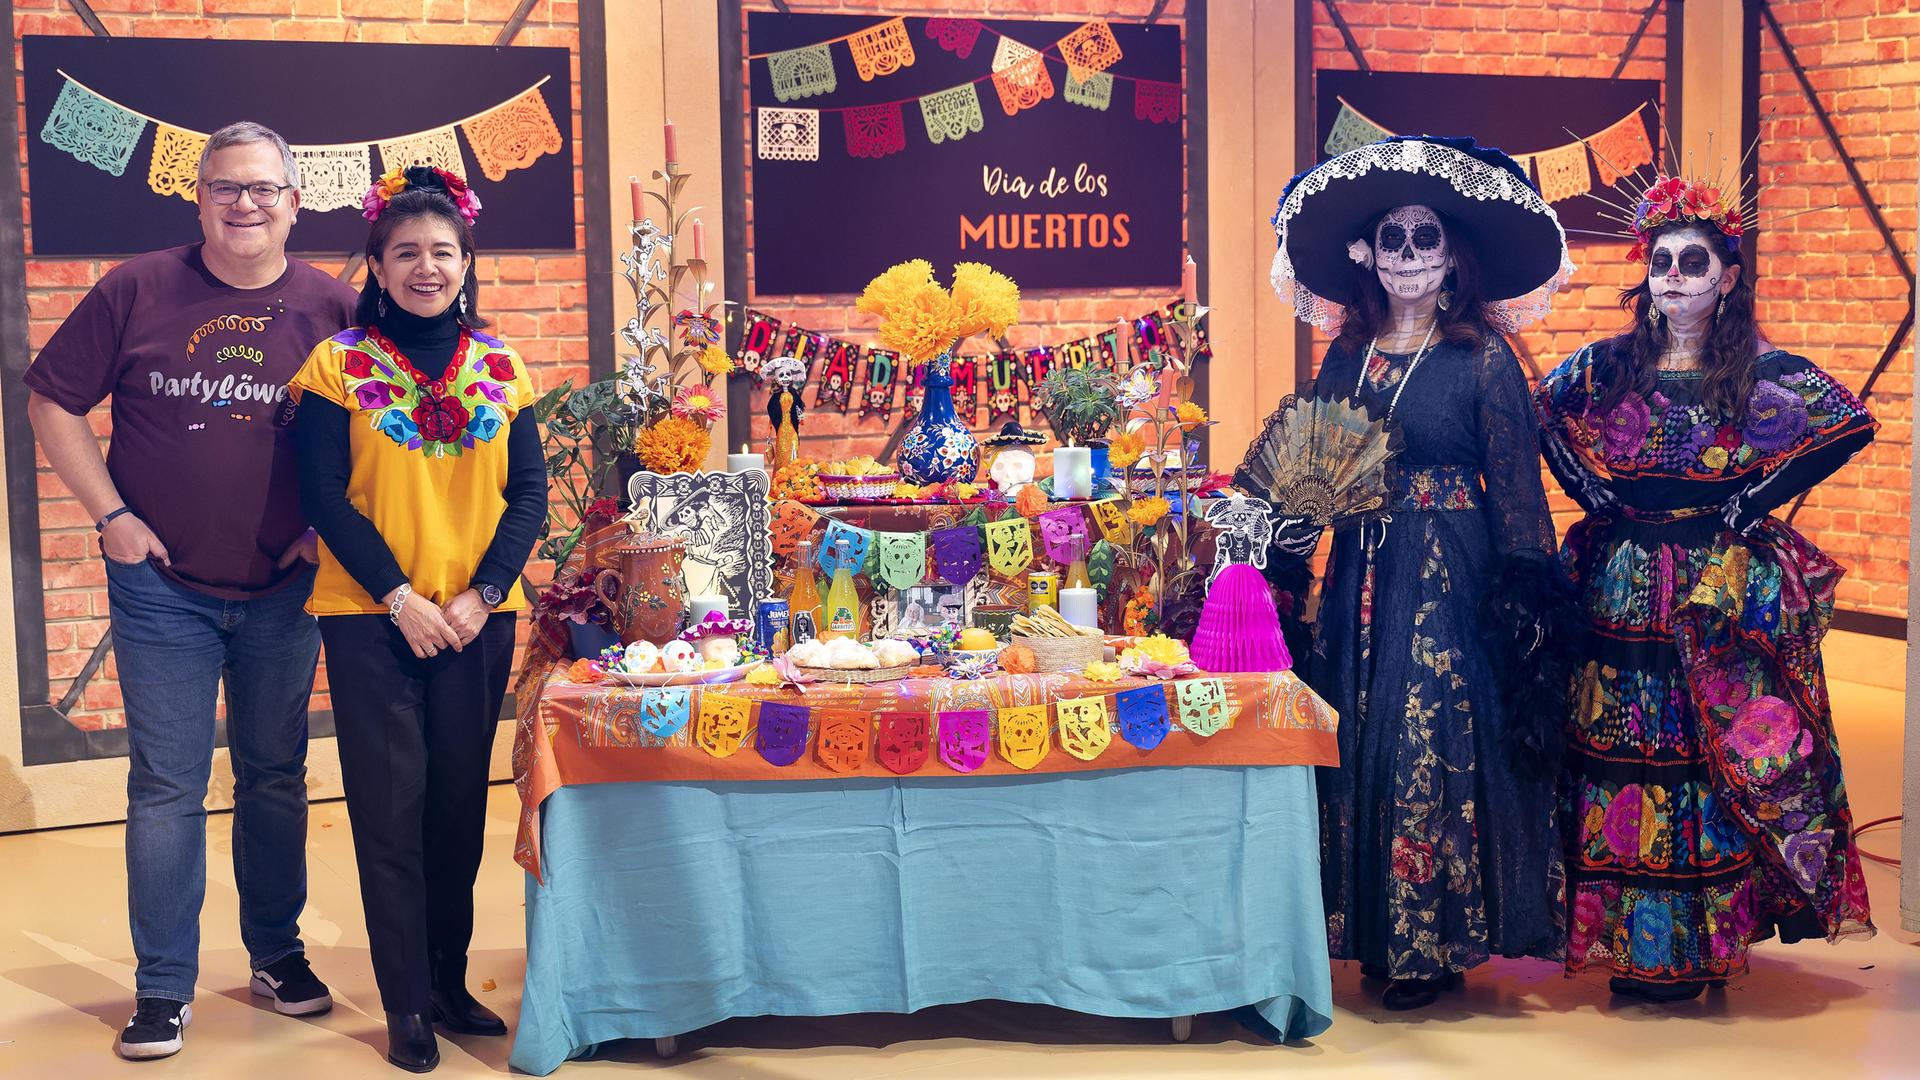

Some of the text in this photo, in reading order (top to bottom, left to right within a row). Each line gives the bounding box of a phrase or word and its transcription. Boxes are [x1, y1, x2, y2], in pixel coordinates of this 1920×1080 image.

[929, 97, 971, 116] WELCOME
[983, 162, 1108, 199] Dia de los
[960, 213, 1130, 250] MUERTOS
